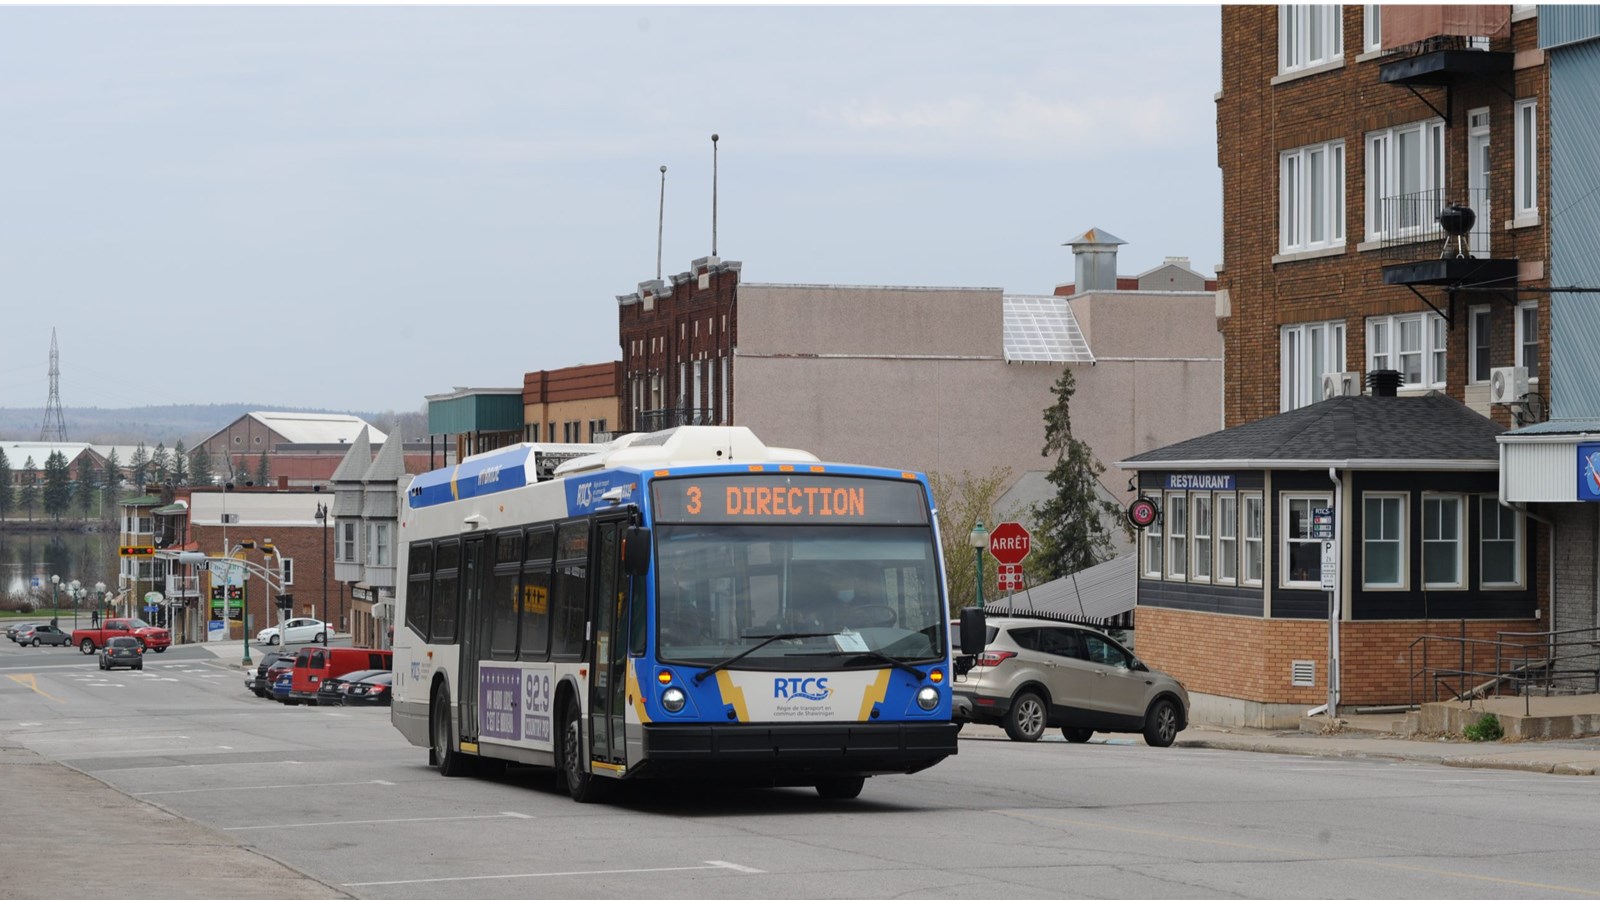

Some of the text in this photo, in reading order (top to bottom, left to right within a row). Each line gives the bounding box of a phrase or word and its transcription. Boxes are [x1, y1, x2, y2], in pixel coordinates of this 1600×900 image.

[1170, 474, 1230, 489] RESTAURANT
[687, 486, 865, 516] 3 DIRECTION
[992, 535, 1028, 550] ARRÊT
[1326, 542, 1332, 553] P
[526, 674, 550, 712] 92.9
[774, 678, 828, 700] RTCS
